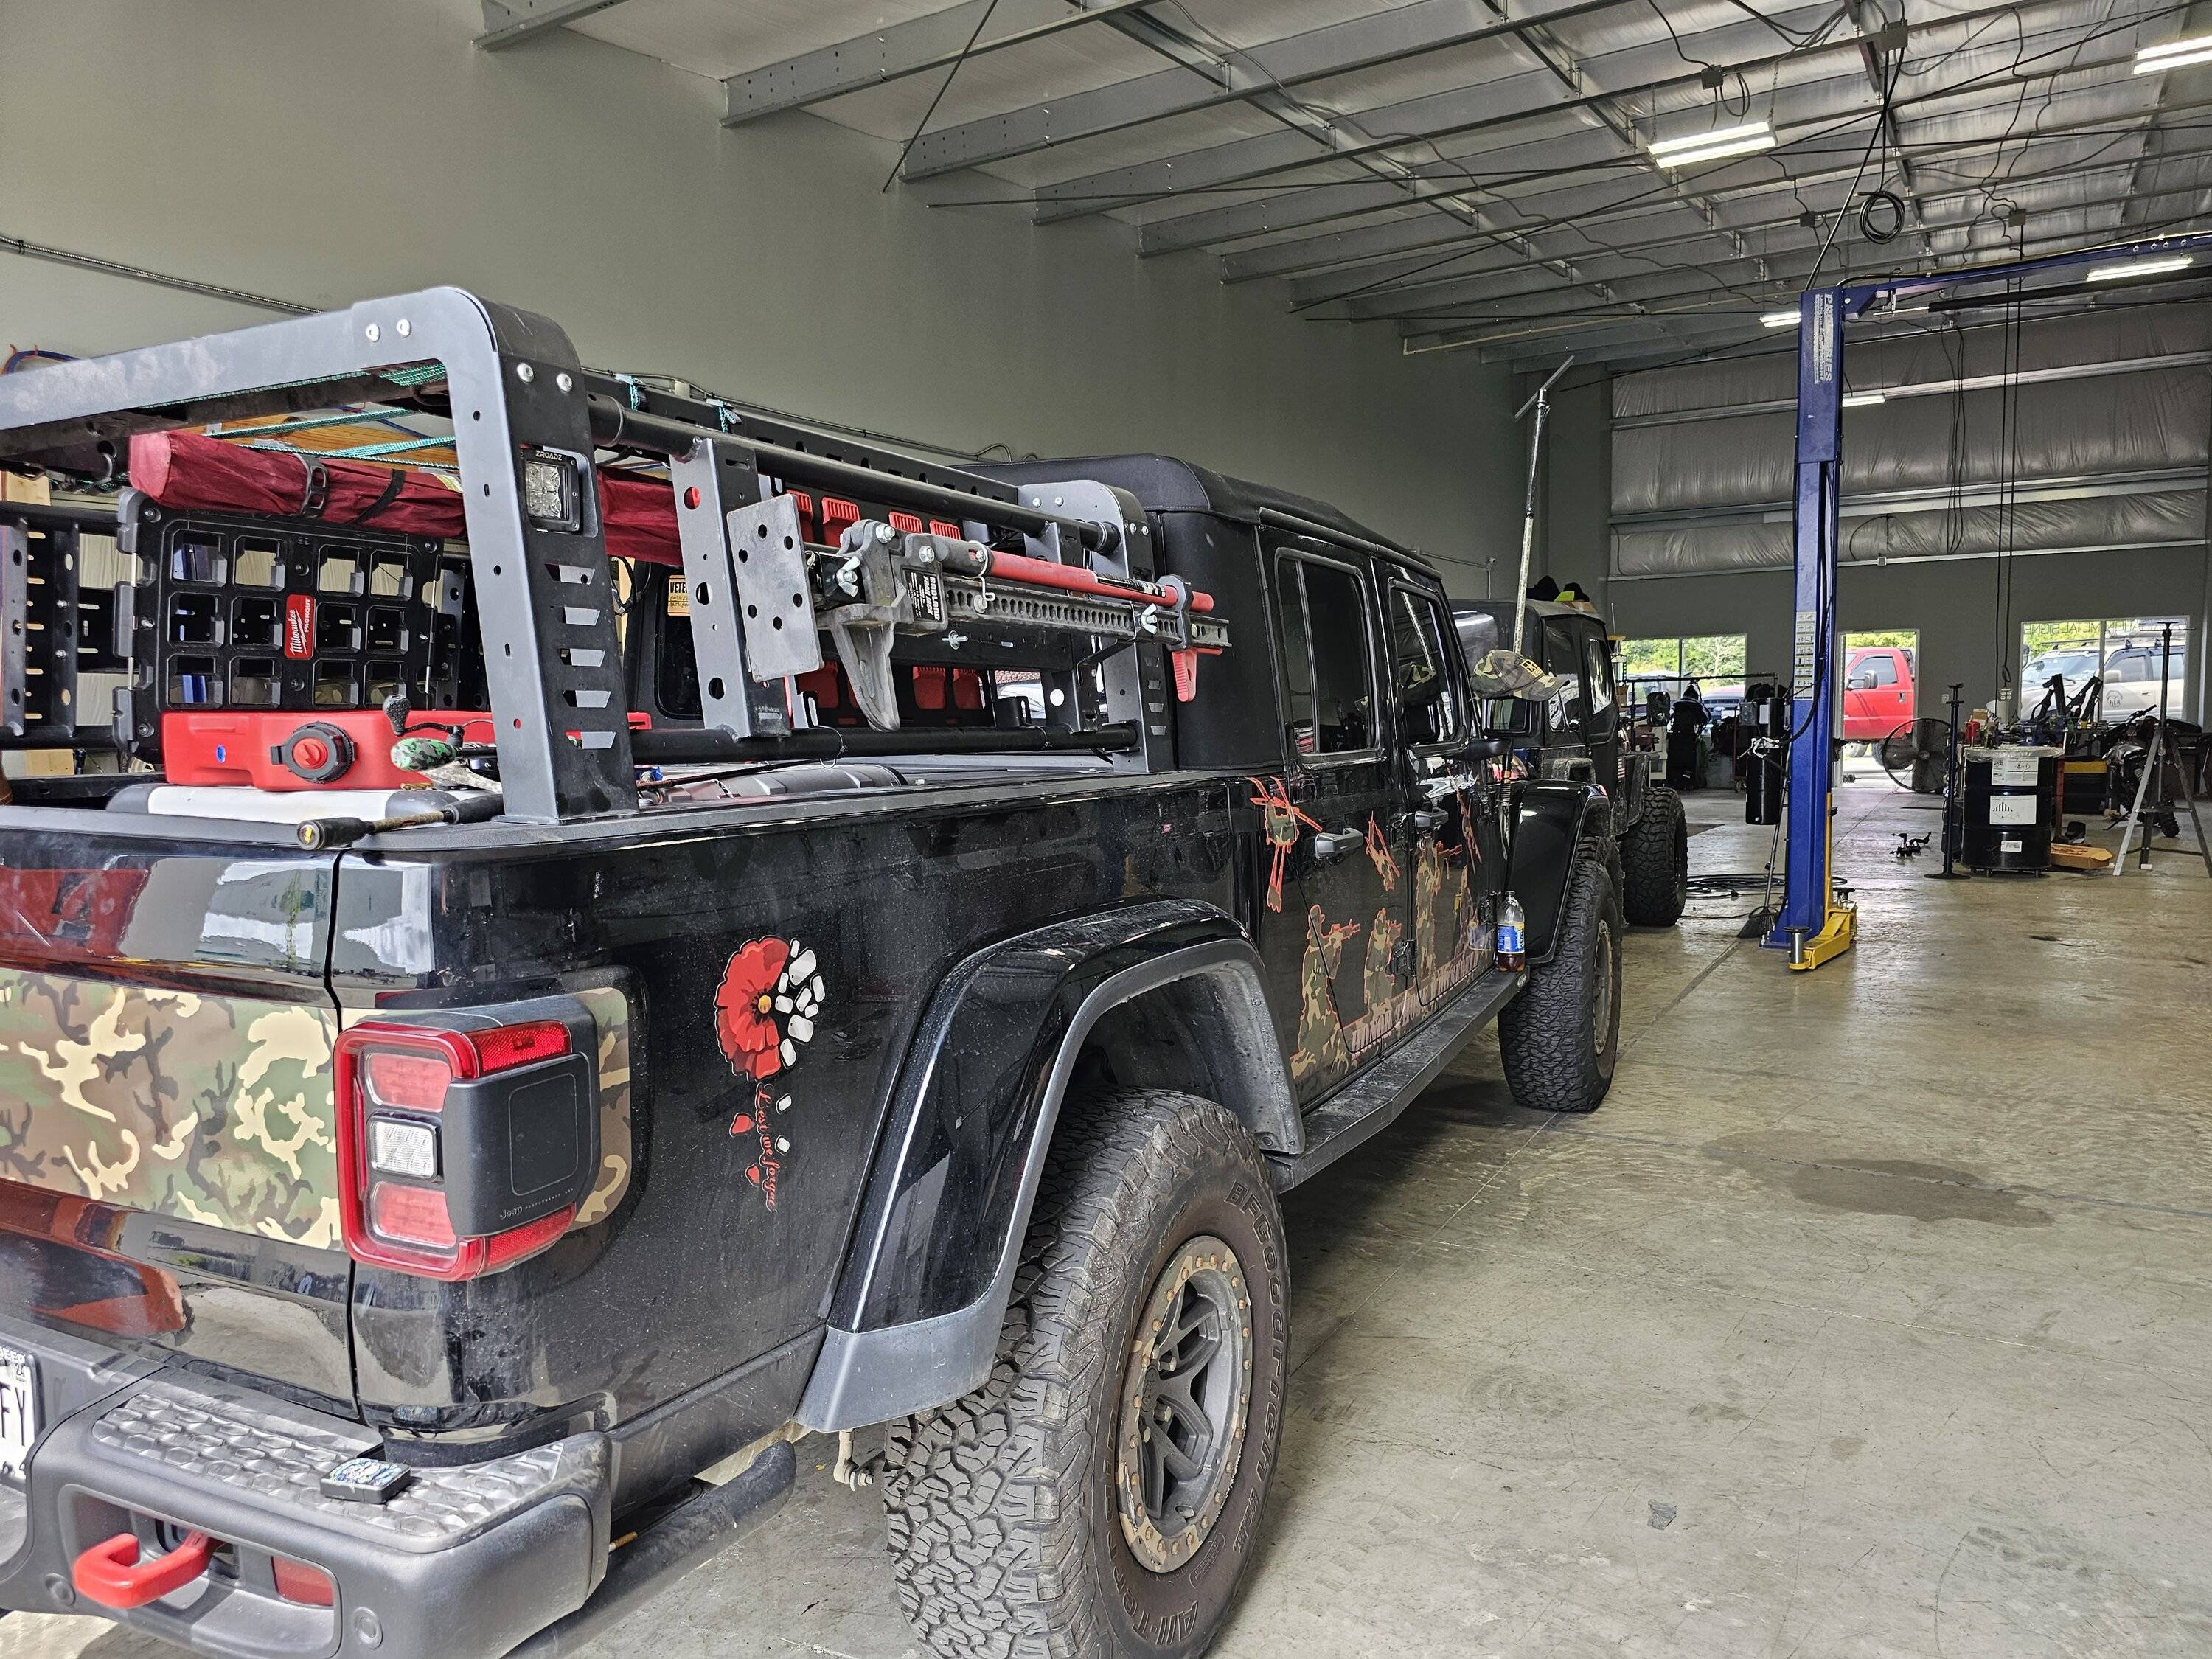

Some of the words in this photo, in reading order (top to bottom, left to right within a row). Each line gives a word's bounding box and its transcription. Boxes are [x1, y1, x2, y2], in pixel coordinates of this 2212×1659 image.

[535, 450, 563, 461] ZROADZ
[669, 581, 688, 594] VETE
[288, 608, 303, 655] Milwaukee
[755, 1082, 774, 1134] Lest
[761, 1134, 773, 1155] we
[500, 1206, 523, 1220] Jeep
[1224, 1179, 1285, 1481] BFGoodrich
